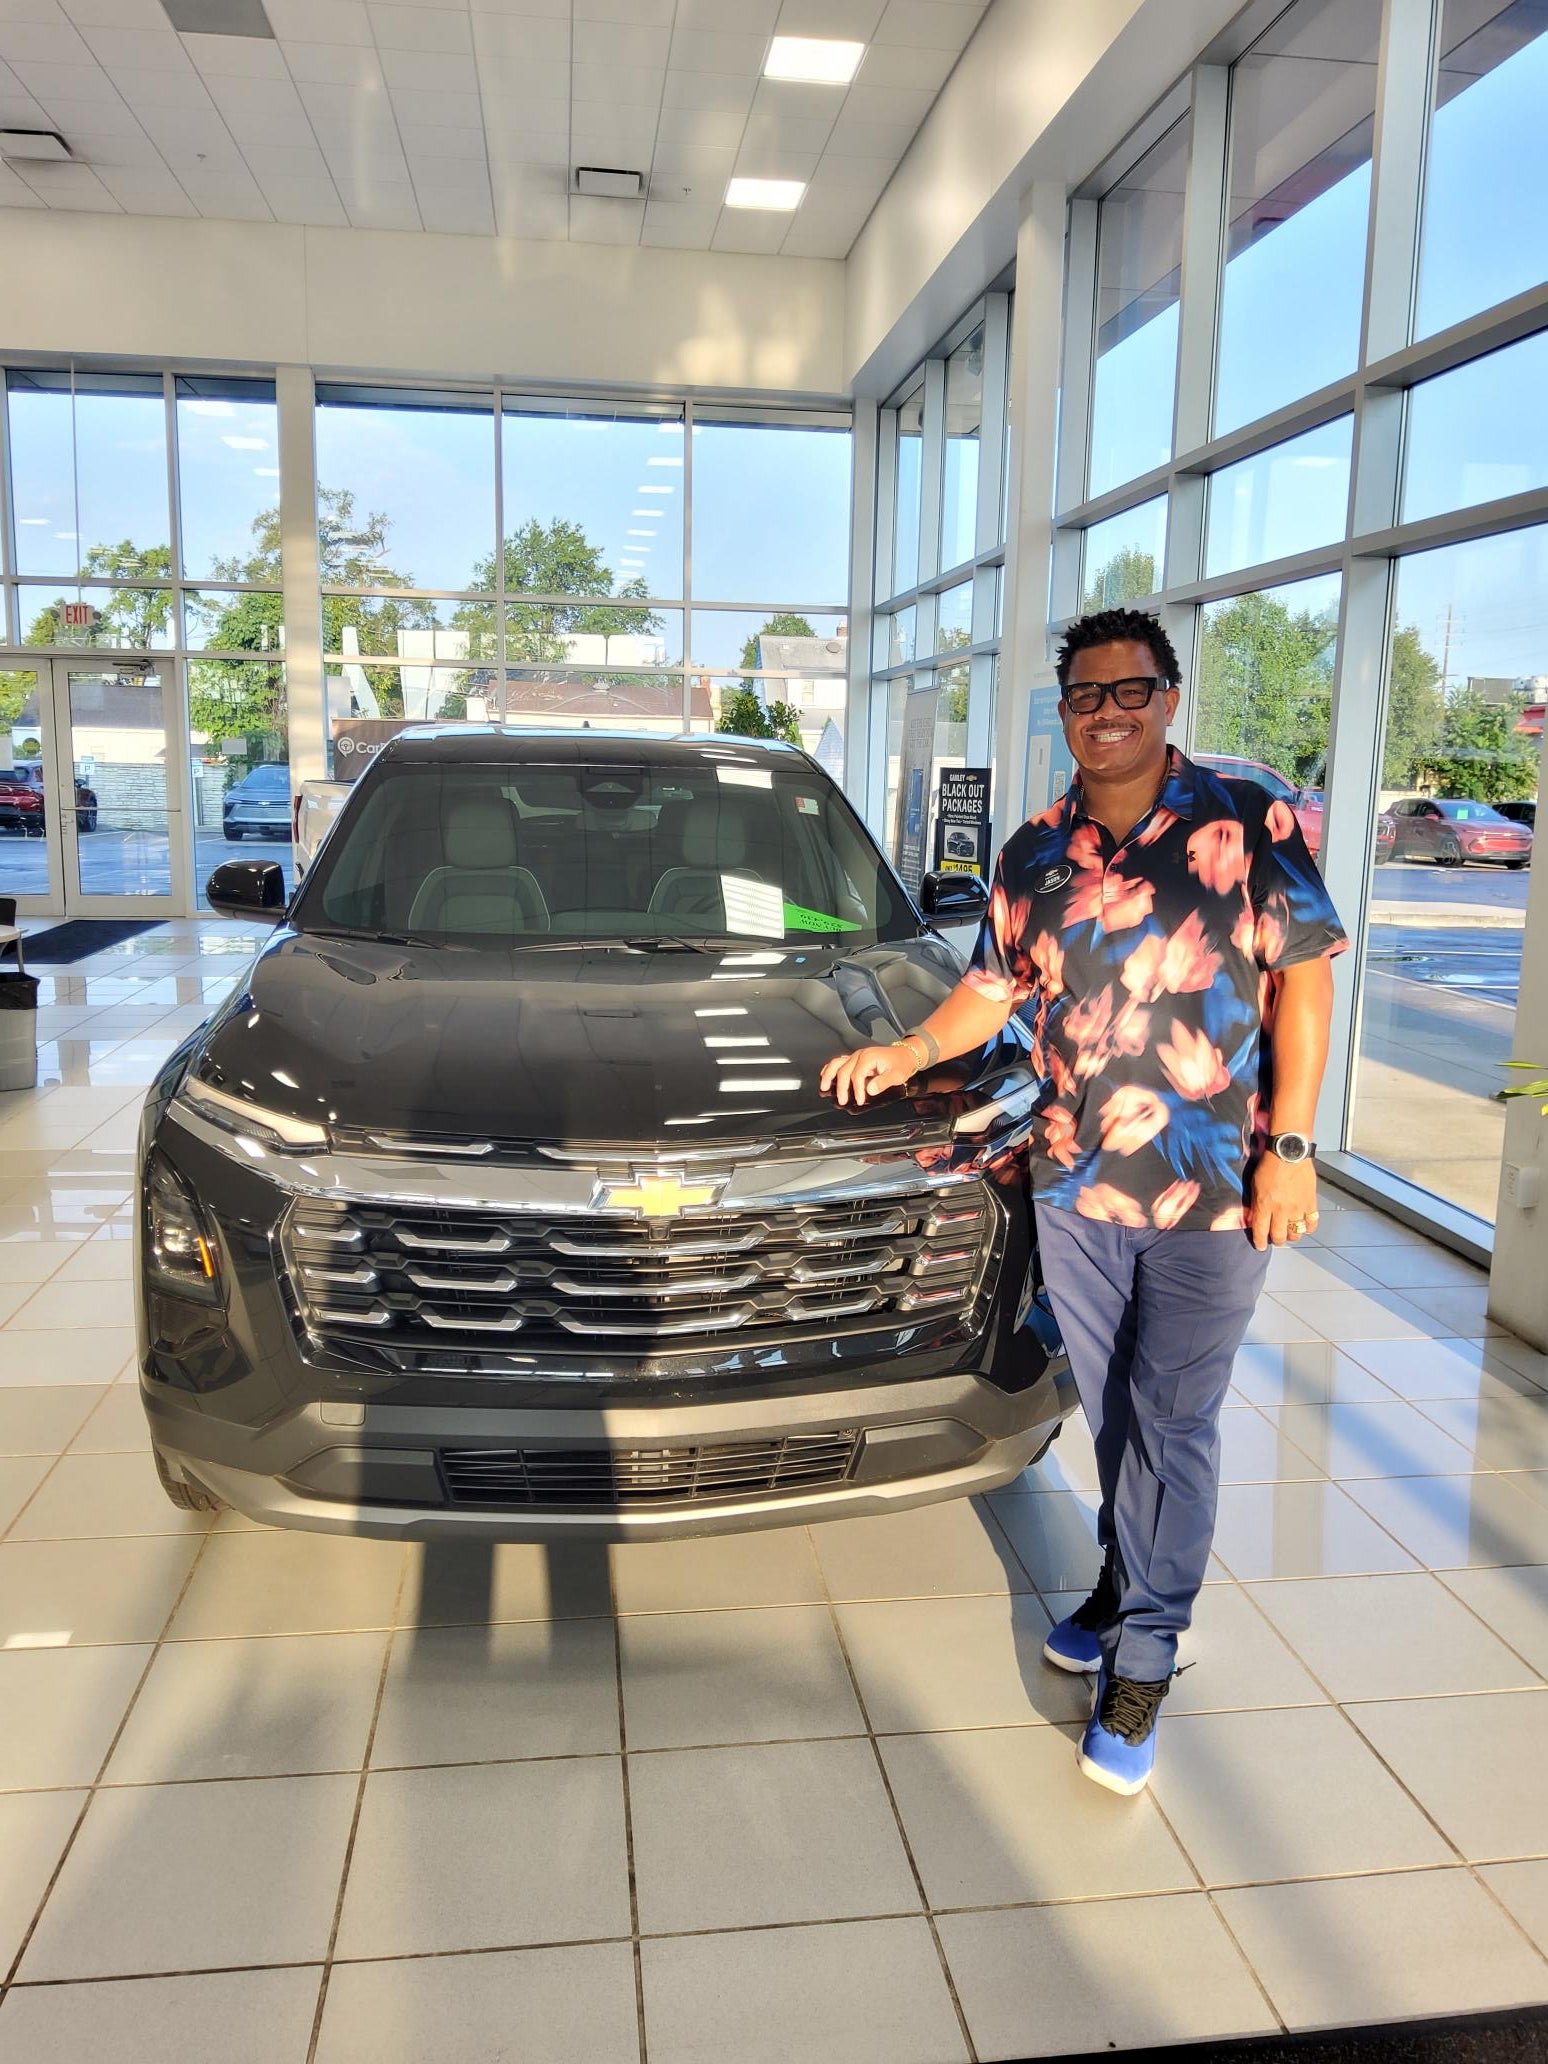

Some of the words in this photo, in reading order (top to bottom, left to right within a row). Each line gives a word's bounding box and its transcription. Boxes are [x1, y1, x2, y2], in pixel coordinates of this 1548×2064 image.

[66, 605, 88, 624] EXIT
[356, 742, 387, 753] Car
[942, 783, 967, 797] BLACK
[968, 784, 984, 798] OUT
[942, 798, 983, 813] PACKAGES
